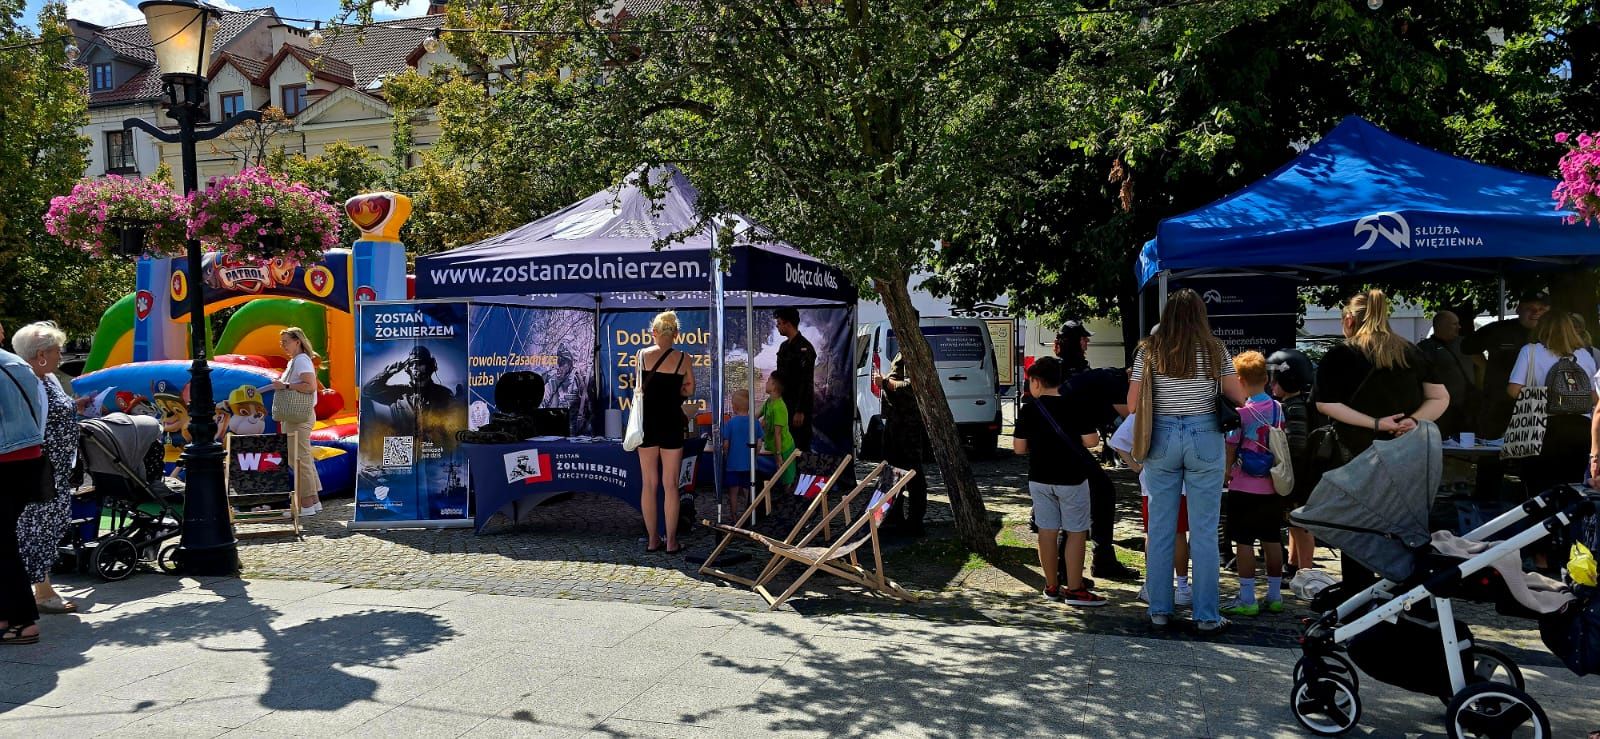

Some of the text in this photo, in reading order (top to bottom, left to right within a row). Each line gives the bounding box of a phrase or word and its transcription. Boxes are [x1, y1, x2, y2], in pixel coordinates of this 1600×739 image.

[1415, 225, 1460, 236] SŁUŻBA
[1415, 237, 1484, 248] WIĘZIENNA
[225, 268, 265, 280] PATROL
[431, 256, 732, 284] www.zostanzolnierzem.
[785, 262, 813, 289] Dołącz
[813, 266, 823, 287] do
[375, 309, 423, 324] ZOSTAŃ
[375, 325, 454, 338] ŻOŁNIERZEM
[556, 461, 627, 478] ŻOŁNIERZEM
